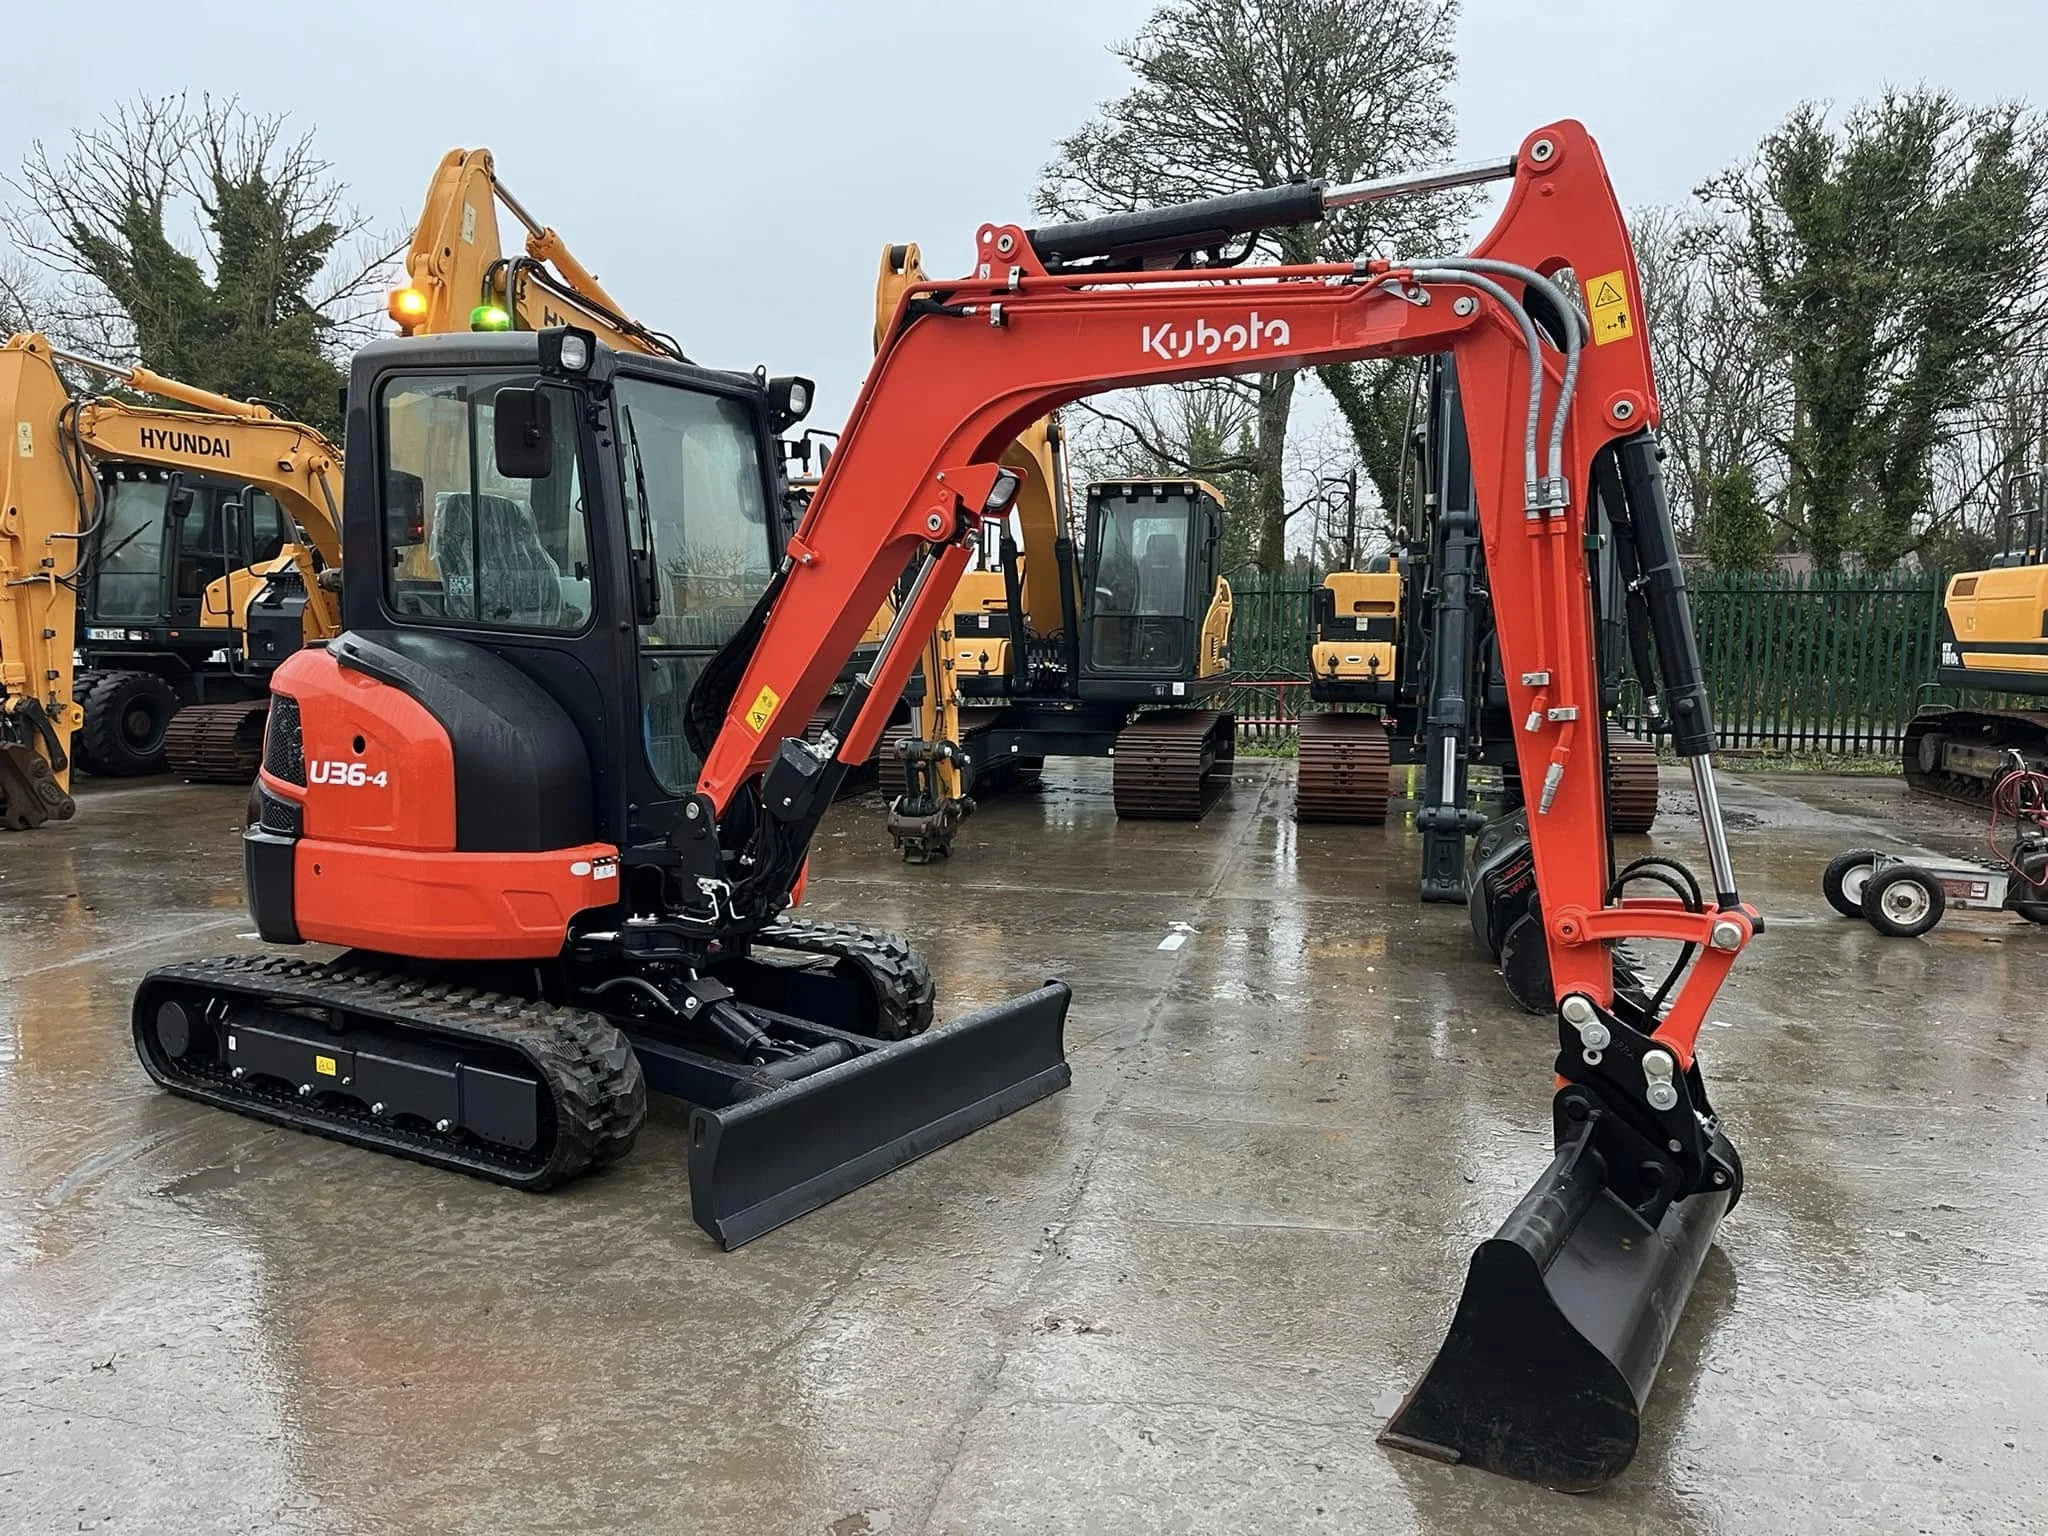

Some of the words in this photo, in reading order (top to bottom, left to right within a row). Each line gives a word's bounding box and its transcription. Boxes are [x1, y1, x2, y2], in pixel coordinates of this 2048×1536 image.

[1142, 311, 1290, 360] Kubota
[140, 427, 231, 458] HYUNDAI
[309, 760, 388, 787] U36-4
